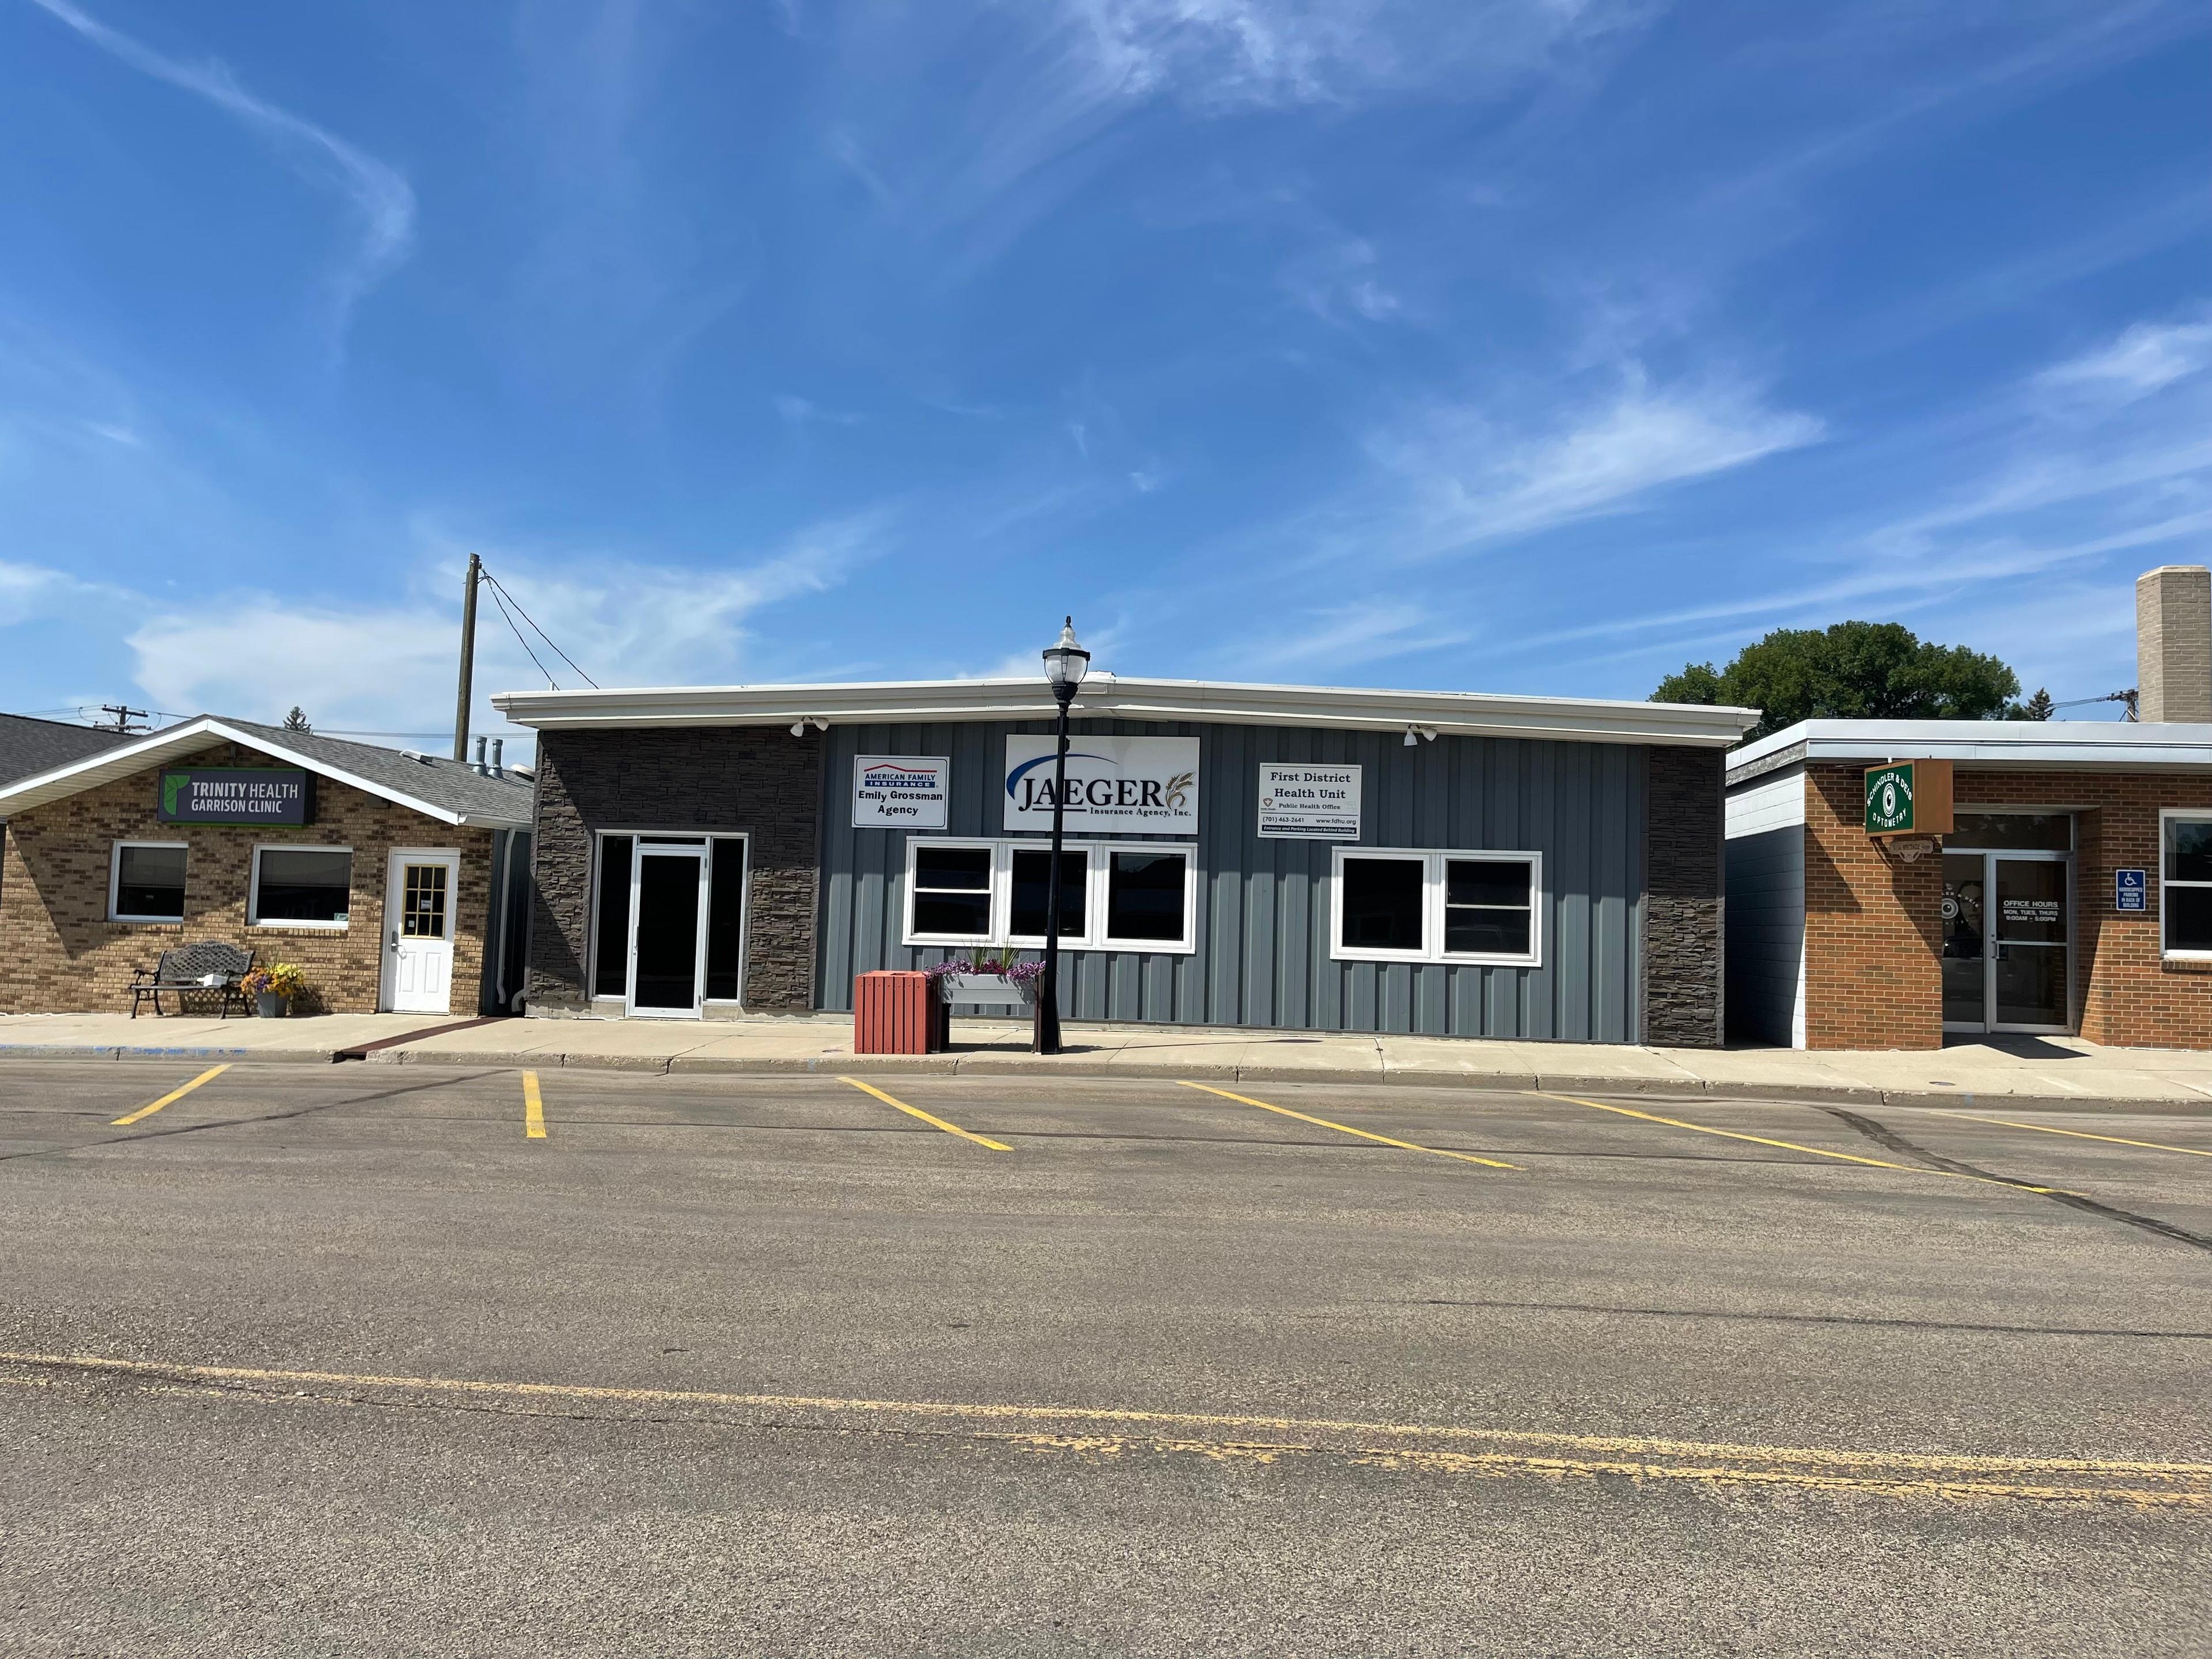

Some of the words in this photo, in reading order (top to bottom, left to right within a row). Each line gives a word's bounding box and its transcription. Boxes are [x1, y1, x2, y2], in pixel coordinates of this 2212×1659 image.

[1270, 772, 1300, 782] First
[1304, 772, 1351, 782] District
[192, 781, 248, 798] TRINITY
[249, 783, 299, 799] HEALTH
[1018, 778, 1164, 812] JAEGER
[1274, 788, 1315, 798] Health
[1319, 789, 1346, 799] Unit
[1866, 772, 1895, 807] SCHINDLER
[1895, 774, 1900, 784] &
[1900, 778, 1912, 801] DEIS
[858, 790, 887, 802] Emily
[890, 791, 943, 801] Grossman
[191, 800, 246, 813] GARRISON
[248, 800, 283, 813] CLINIC
[878, 805, 919, 816] Agency
[1090, 807, 1133, 815] Insurance
[1136, 808, 1171, 817] Agency,
[1872, 808, 1907, 828] OPTOMETRY
